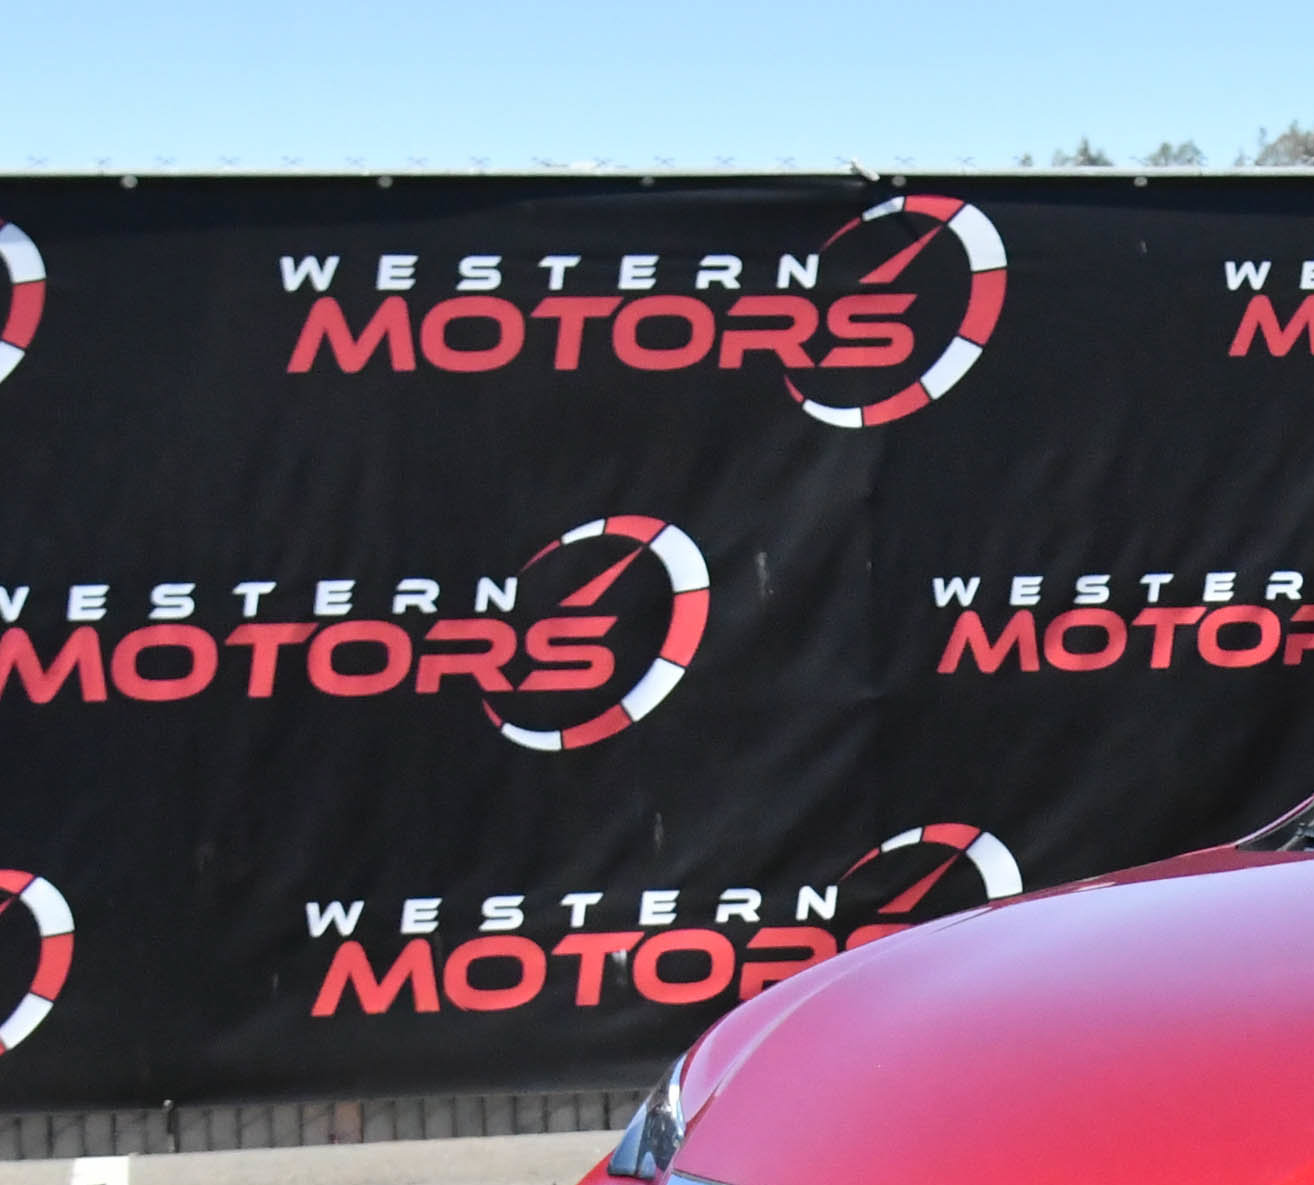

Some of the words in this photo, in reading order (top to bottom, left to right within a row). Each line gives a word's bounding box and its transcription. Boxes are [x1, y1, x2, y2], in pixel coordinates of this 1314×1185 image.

[280, 254, 820, 292] WESTERN
[287, 293, 917, 374] MOTORS
[0, 615, 618, 705] MOTORS
[306, 885, 838, 938] WESTERN
[311, 923, 914, 1017] MOTOR
